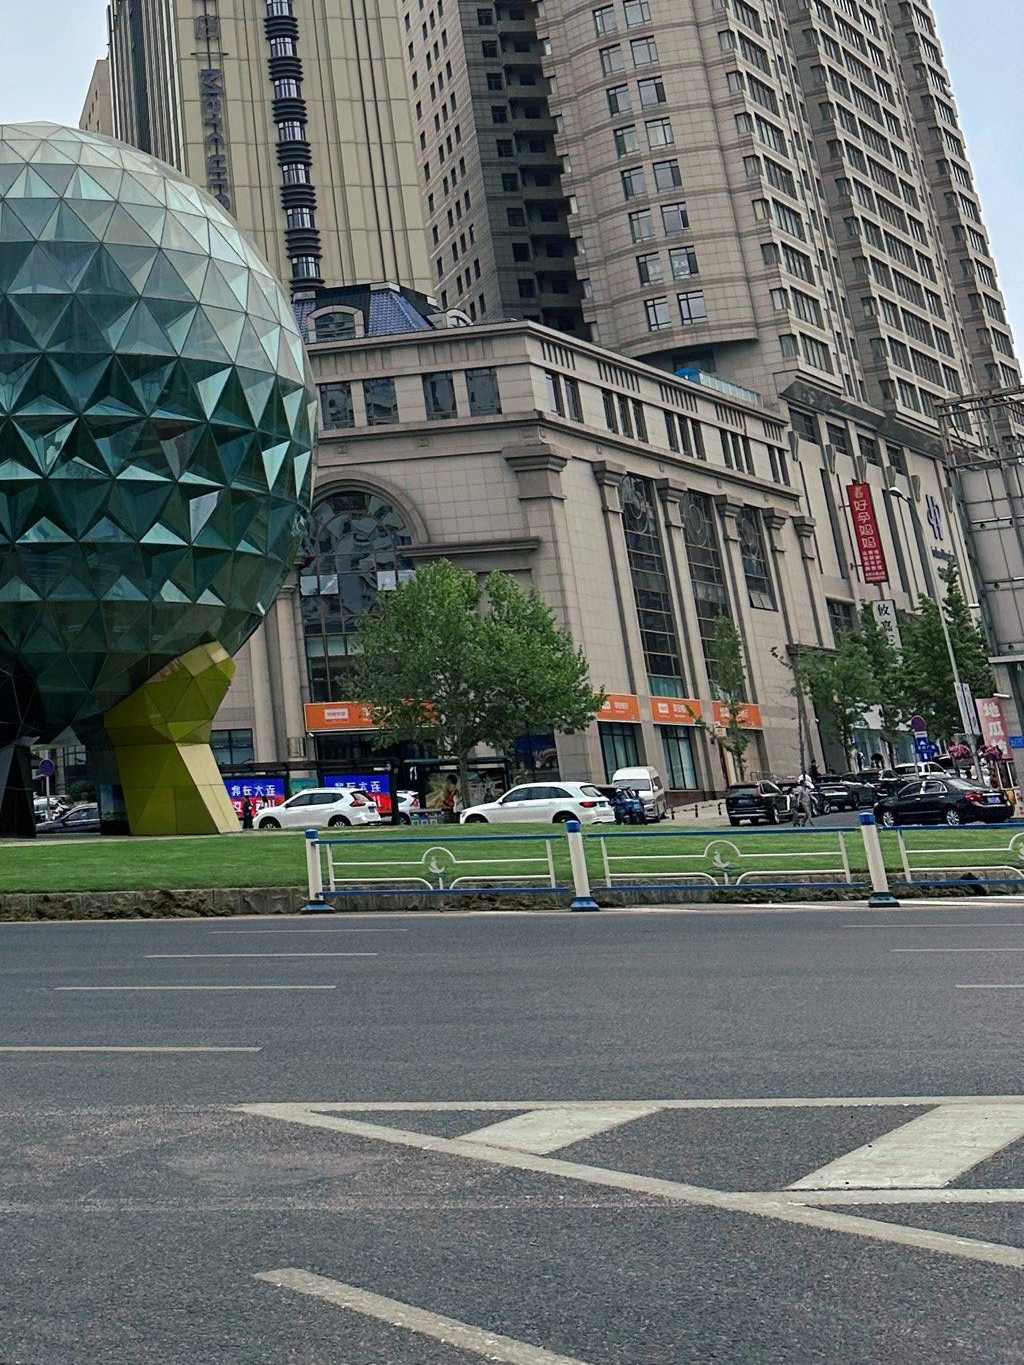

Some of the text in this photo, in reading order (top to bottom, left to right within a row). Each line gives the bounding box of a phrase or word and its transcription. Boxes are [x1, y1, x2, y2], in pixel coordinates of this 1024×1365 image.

[200, 69, 230, 211] Mercure
[853, 499, 877, 549] 好孕妈妈
